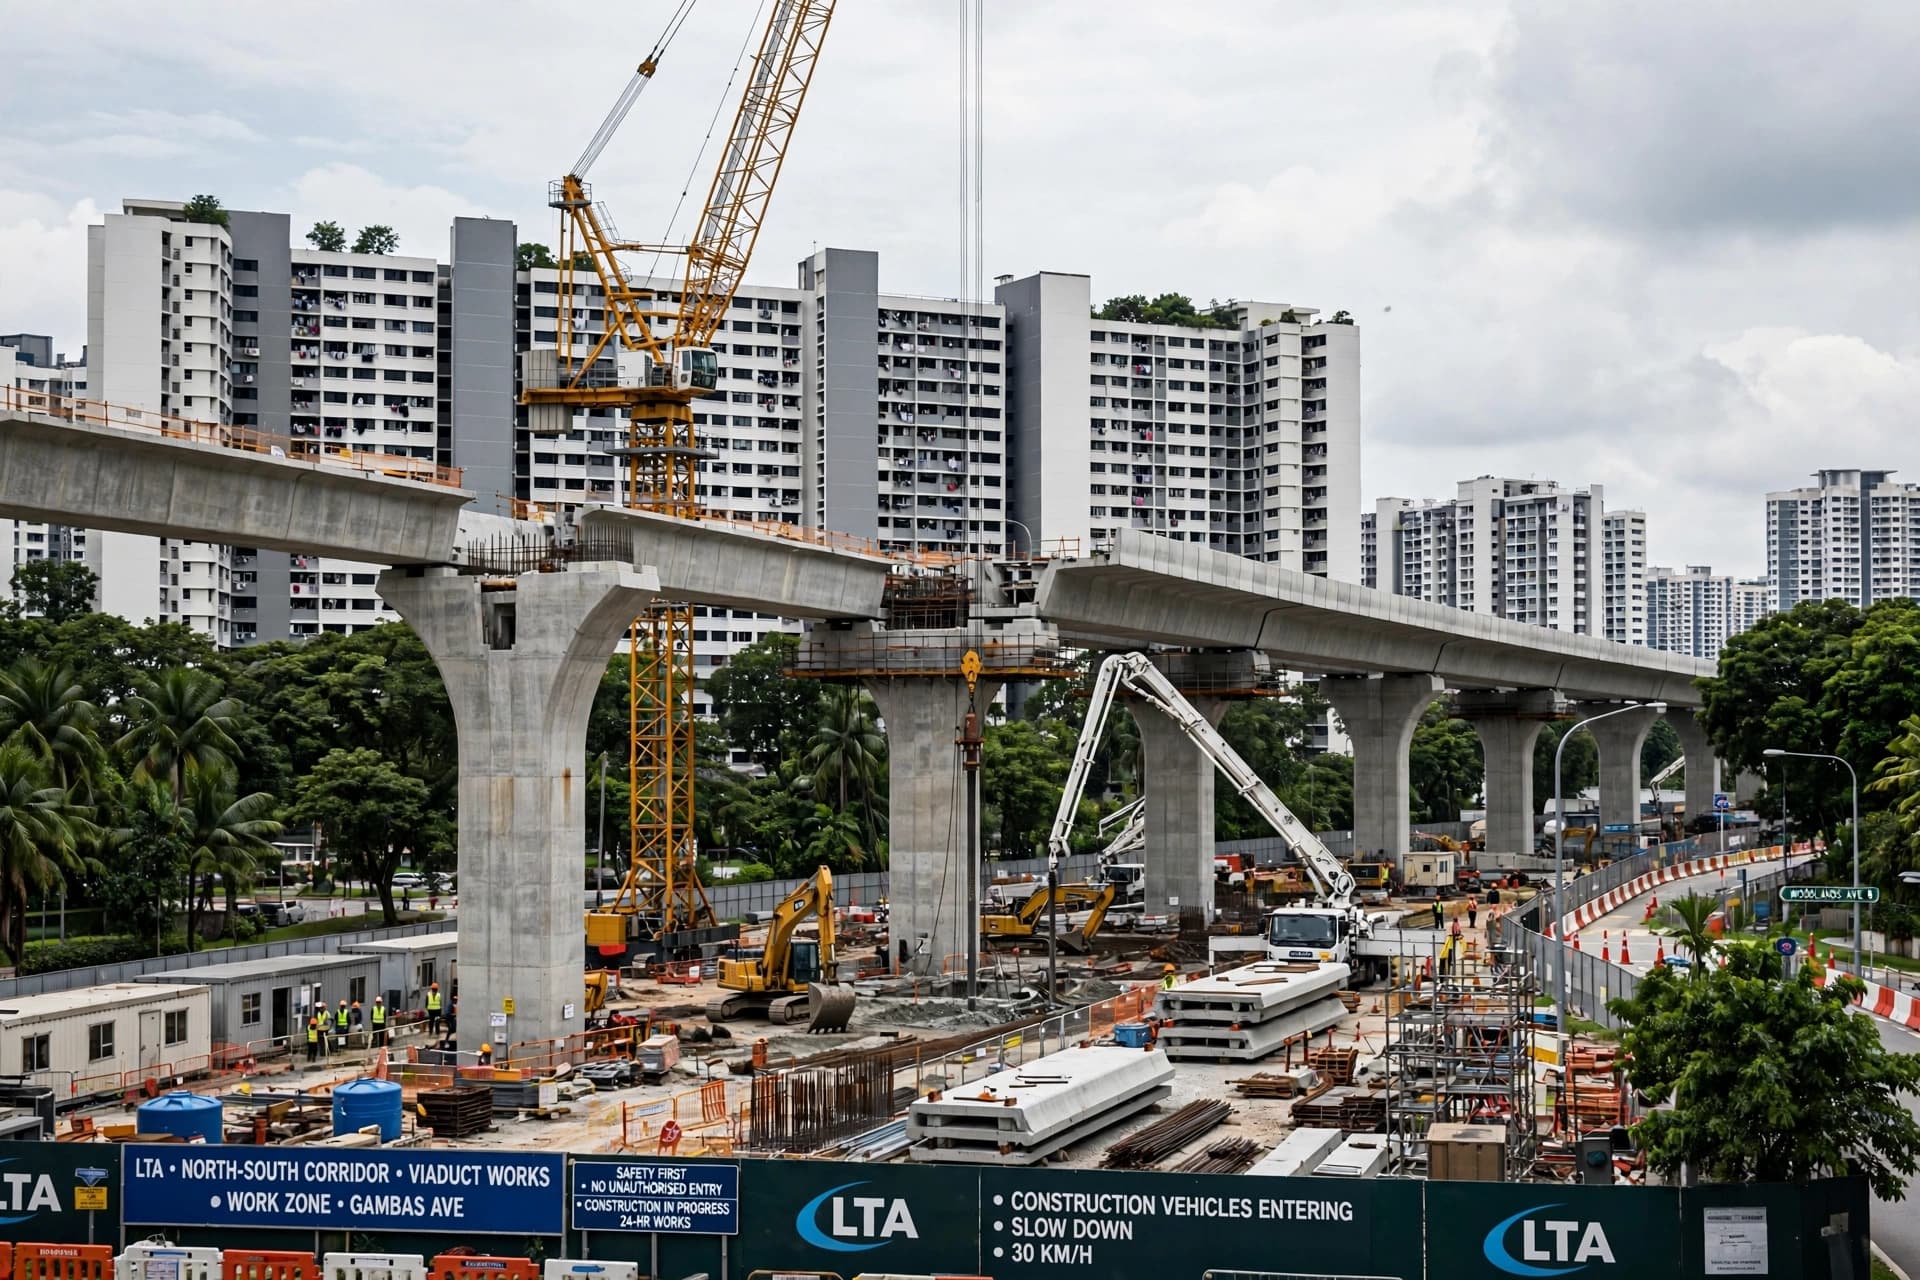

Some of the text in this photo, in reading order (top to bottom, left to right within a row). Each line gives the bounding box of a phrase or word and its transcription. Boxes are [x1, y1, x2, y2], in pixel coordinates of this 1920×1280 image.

[136, 1158, 550, 1187] LTA NORTH-SOUTH CORRIDOR VIADUCT WORKS
[616, 1167, 687, 1180] SAFETY FIRST
[0, 1173, 62, 1212] TA
[591, 1180, 722, 1196] NO UNAUTHORISED ENTRY
[227, 1192, 464, 1217] WORK ZONE GAMBAS AVE
[585, 1199, 730, 1215] CONSTRUCTION IN PROGRESS
[1012, 1191, 1353, 1221] CONSTRUCTION VEHICLES ENTERING
[620, 1215, 691, 1229] 24-HR WORKS
[833, 1197, 918, 1238] LTA
[1012, 1217, 1133, 1240] SLOW DOWN
[1524, 1219, 1616, 1263] LTA
[1011, 1243, 1092, 1264] 30 KM/H
